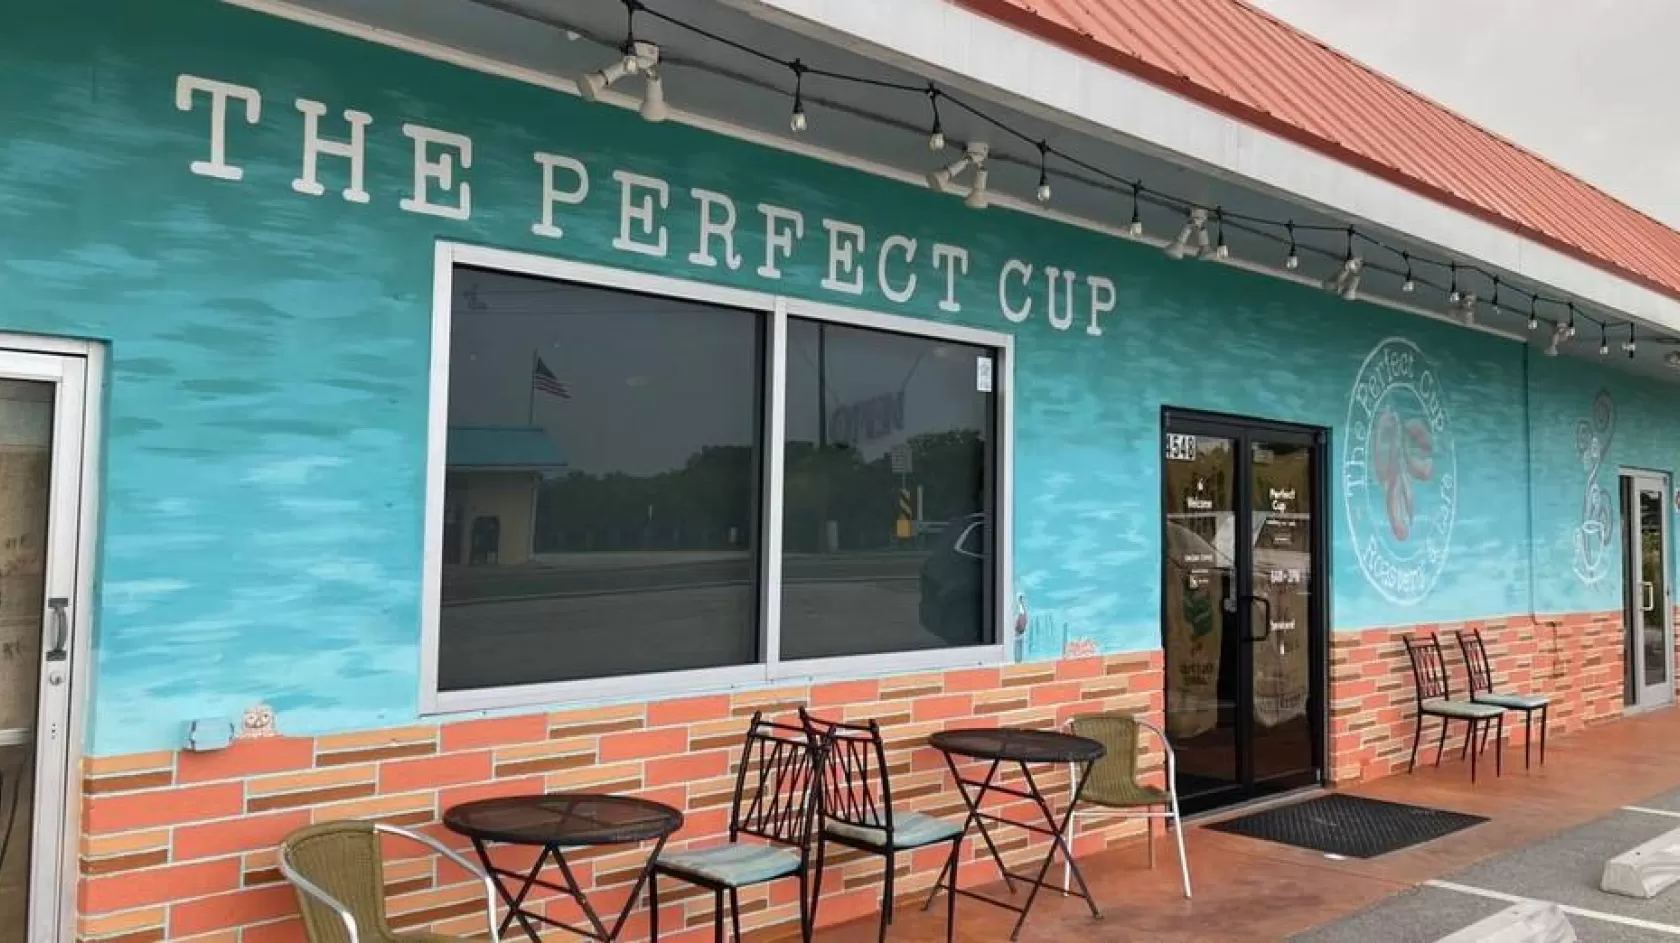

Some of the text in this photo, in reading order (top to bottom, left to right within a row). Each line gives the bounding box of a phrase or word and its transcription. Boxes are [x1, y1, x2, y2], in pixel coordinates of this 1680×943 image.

[175, 73, 1117, 336] THE PERFECT CUP
[1345, 347, 1450, 497] The Perfect Cup
